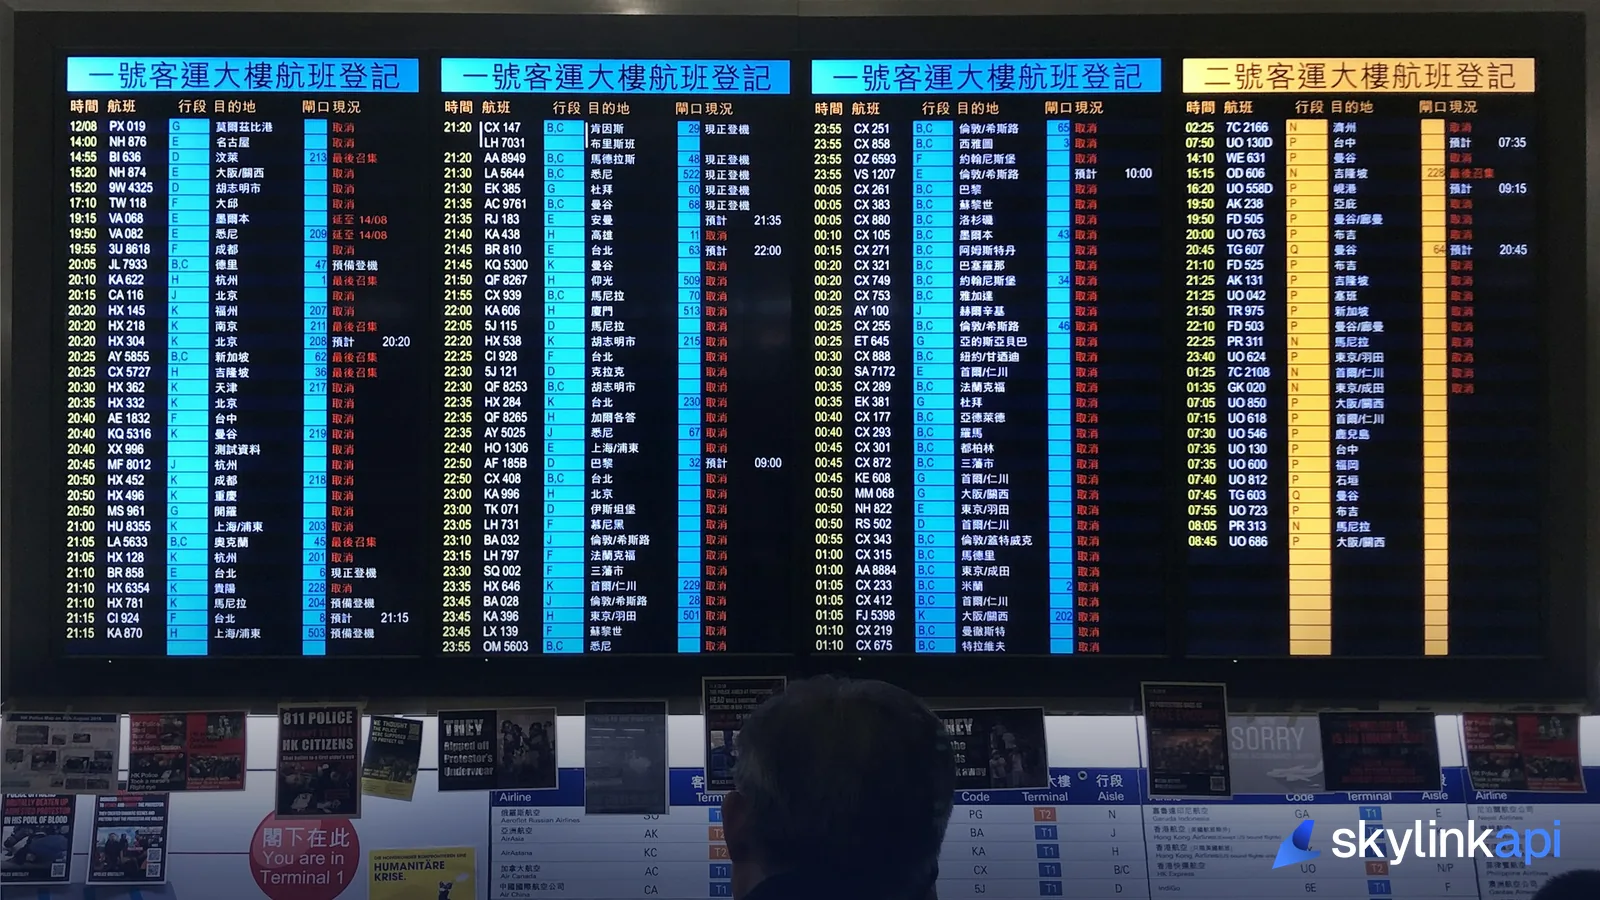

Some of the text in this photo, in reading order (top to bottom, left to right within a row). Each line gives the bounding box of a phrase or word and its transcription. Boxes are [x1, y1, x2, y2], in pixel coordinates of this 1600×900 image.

[88, 61, 401, 90] 一號客運大樓航班登記
[462, 63, 772, 92] 一號客運大樓航班登記
[832, 63, 1142, 92] 一號客運大樓航班登記
[1204, 62, 1516, 90] 二號客運大樓航班登記
[70, 100, 361, 114] 時間 航班 行段 目的地 閘口 現況
[444, 101, 733, 115] 時間 航班 行段 目的地 閘口 現況
[815, 101, 1104, 115] 時間 航班 行段 目的地 閘口 現況
[1186, 100, 1478, 114] 時間 航班 行段 目的地 閘口 現況
[1186, 137, 1526, 148] 07:50 UO 130D P 台中 預計 07:35
[69, 151, 378, 164] 14:55 BI 636 D 汶萊 213 最後召集
[444, 183, 750, 196] 21:30 EK 385 G 杜拜 60 現正登機
[443, 457, 782, 469] 22:50 AF 185B D 巴黎 32 預計 09:00
[815, 580, 1099, 592] 01:05 CX 233 B,C 米蘭 2 取消
[66, 612, 409, 624] 21:15 CI 924 F 台北 8 預計 21:15
[283, 710, 353, 725] 811 POLICE
[443, 718, 484, 736] THEY
[1231, 727, 1305, 750] SORRY
[282, 738, 354, 751] HK CITIZENS
[477, 741, 489, 750] off
[444, 753, 493, 764] Protestor's
[444, 767, 494, 777] Underwear
[1096, 774, 1124, 788] 行段
[499, 792, 532, 802] Airline
[961, 791, 1125, 802] Code Terminal Aisle
[1286, 792, 1448, 802] Code Terminal Aisle
[1475, 791, 1508, 800] Airline
[969, 810, 1116, 820] PG T2 N
[1295, 809, 1442, 818] GA T1 E
[12, 816, 22, 825] HIS
[22, 816, 38, 824] POOL
[39, 816, 47, 824] OF
[48, 815, 68, 824] BLOOD
[263, 827, 350, 848] 閣下在此
[644, 829, 658, 838] AK
[970, 828, 1116, 837] BA T1 J
[644, 848, 727, 857] KC T2
[972, 846, 1119, 856] KA T1 H
[263, 851, 344, 865] You are in
[374, 860, 445, 872] HUMANITÄRE
[645, 866, 727, 876] AC T1
[973, 865, 1130, 875] CX T1 B/C
[1301, 863, 1454, 873] UO T2 N/P
[260, 870, 343, 885] Terminal 1
[374, 872, 406, 882] KRISE.
[644, 885, 727, 895] CA T1
[974, 884, 1123, 894] 5J T1 D
[1305, 883, 1451, 893] 6E T1 F
